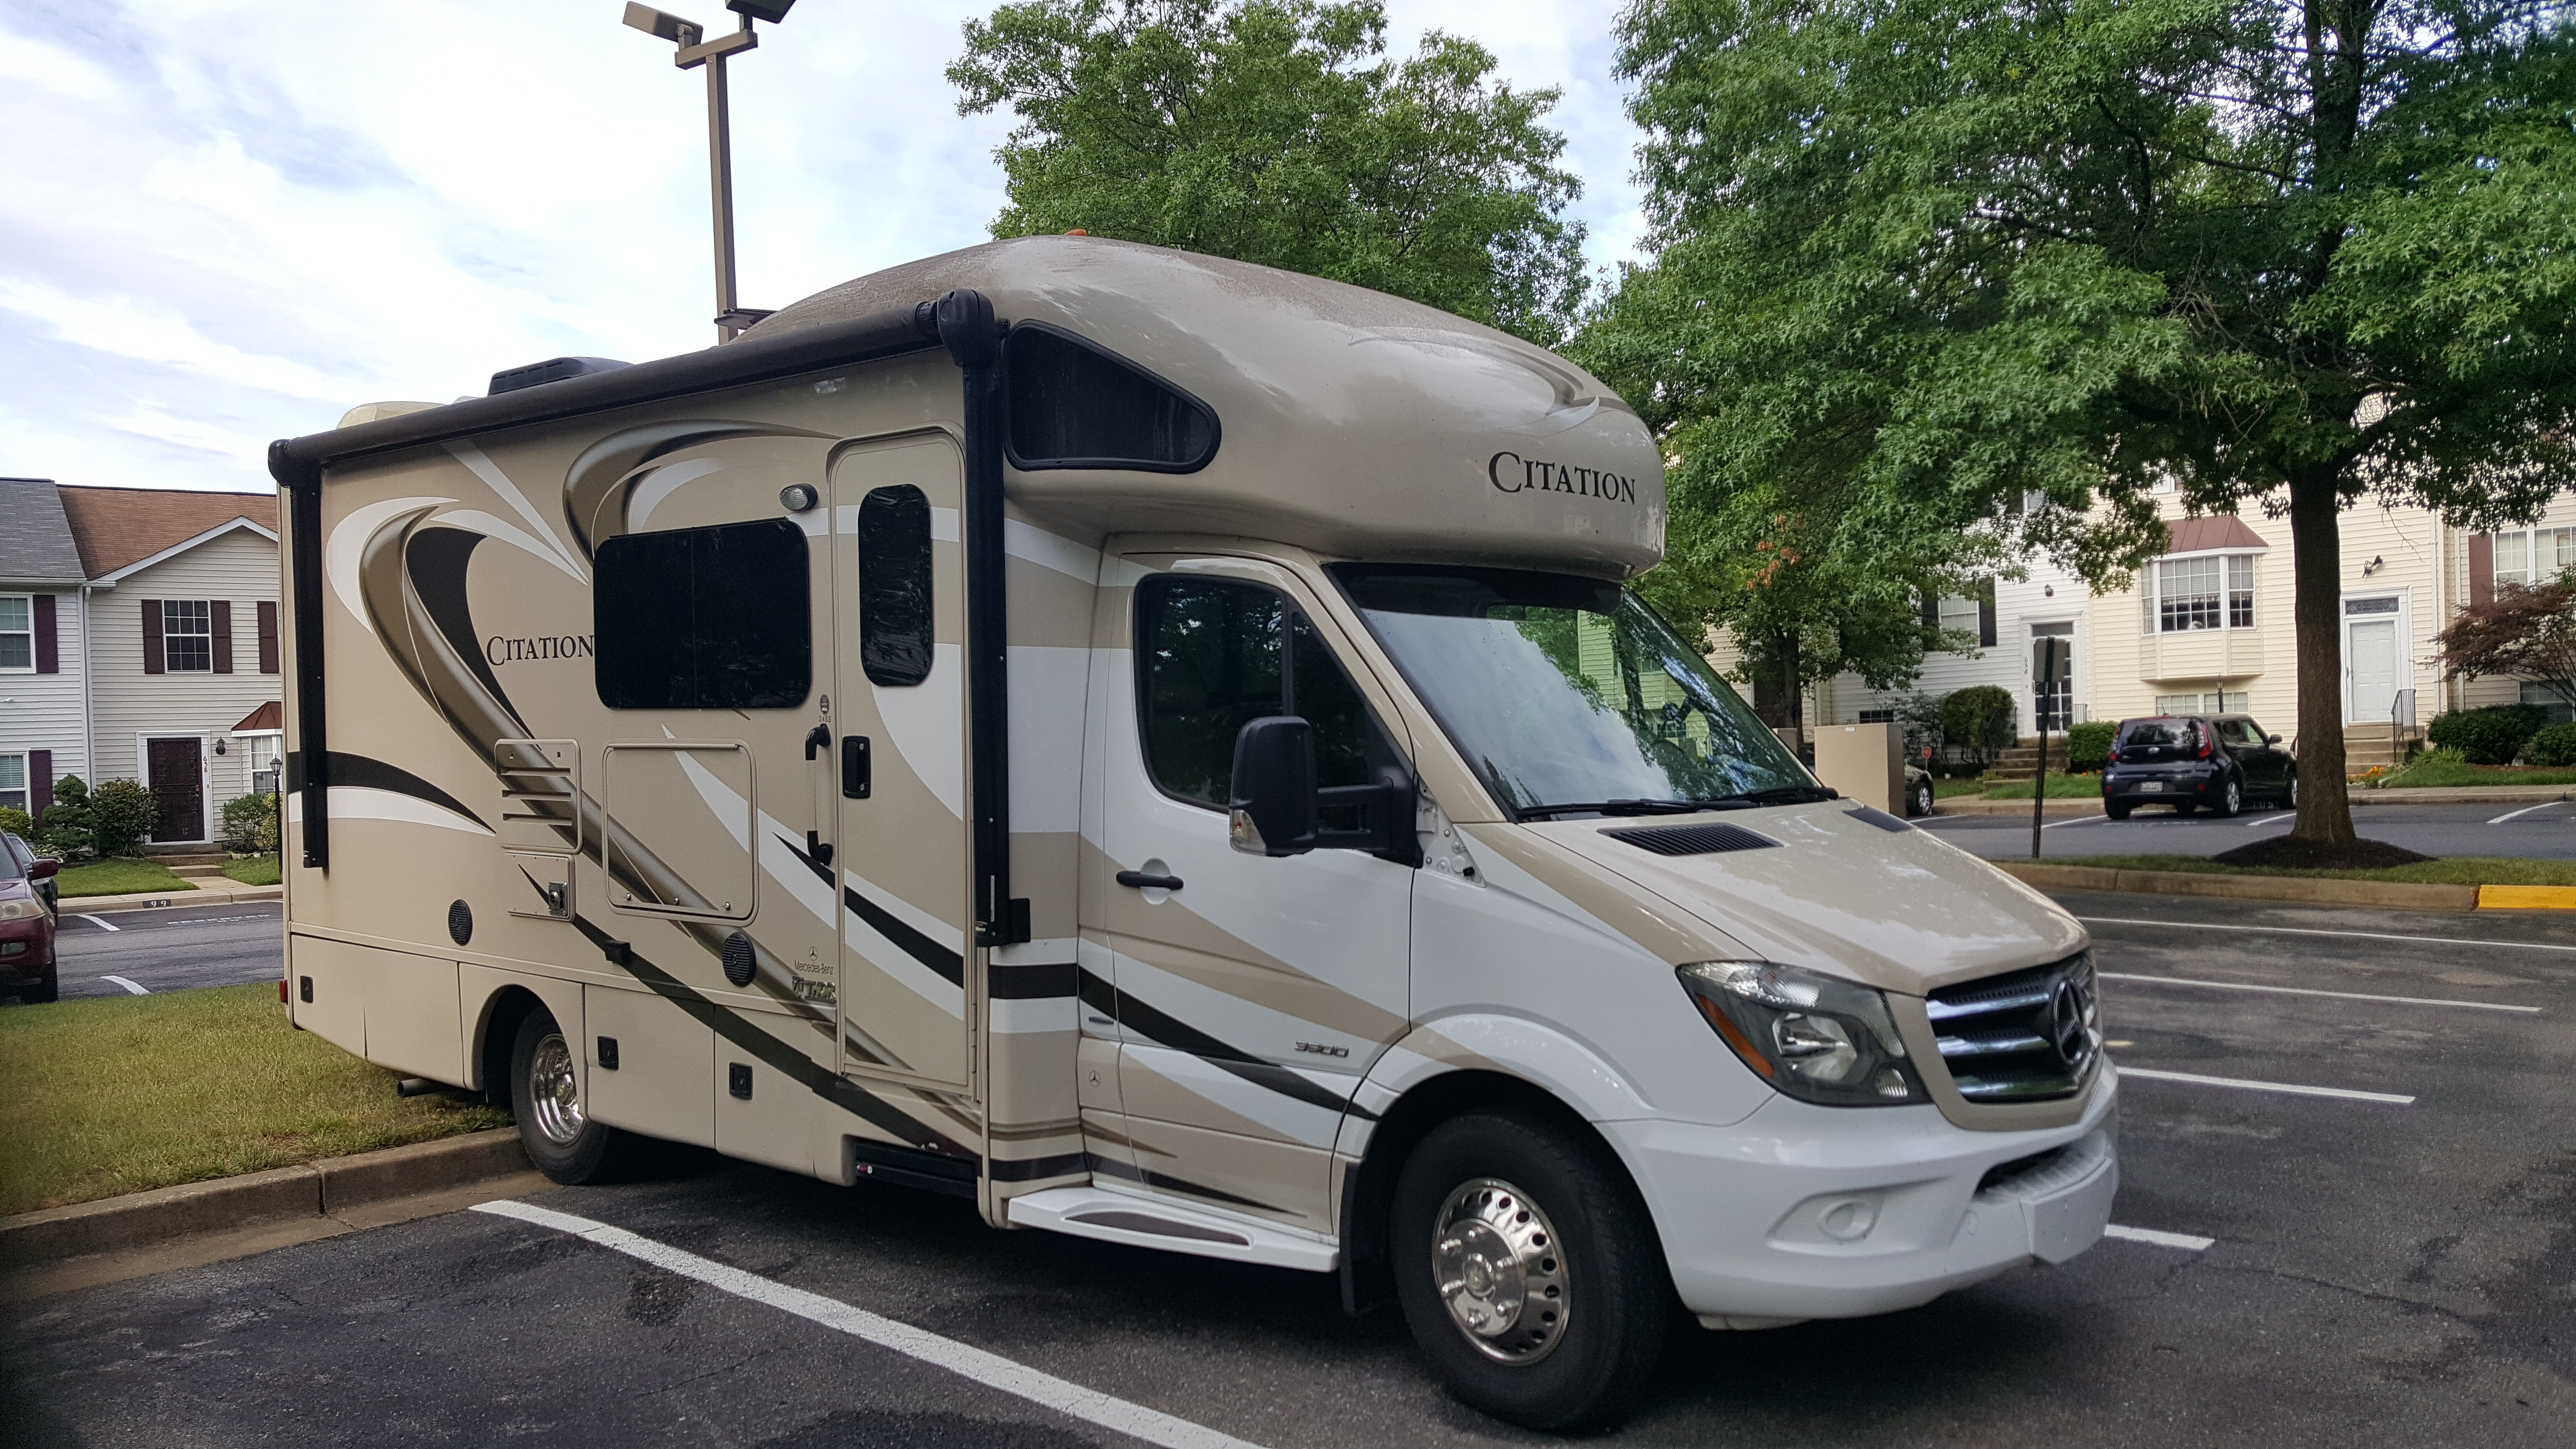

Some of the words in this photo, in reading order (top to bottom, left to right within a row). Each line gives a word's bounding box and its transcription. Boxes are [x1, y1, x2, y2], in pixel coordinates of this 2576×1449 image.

[1488, 451, 1635, 505] CITATION
[486, 635, 594, 666] CITATION
[794, 960, 834, 975] Mercedes-Benz
[1294, 1040, 1349, 1057] 3500
